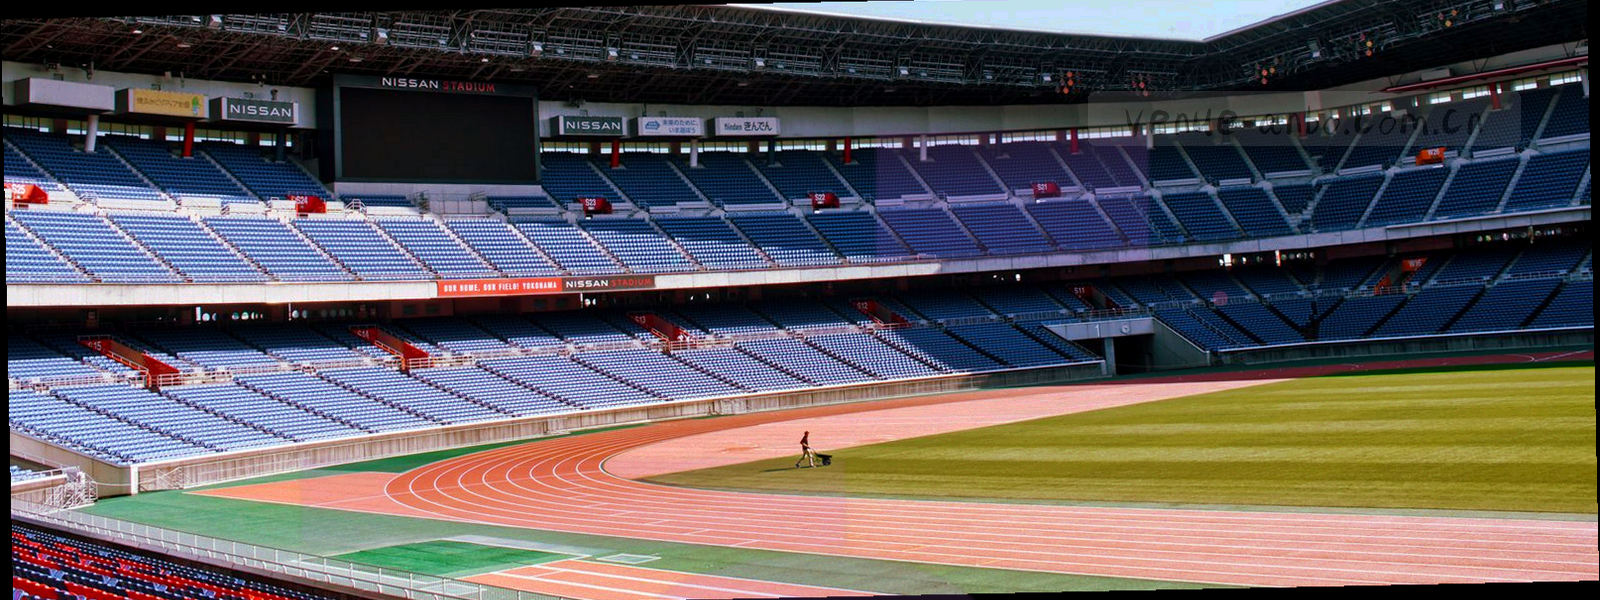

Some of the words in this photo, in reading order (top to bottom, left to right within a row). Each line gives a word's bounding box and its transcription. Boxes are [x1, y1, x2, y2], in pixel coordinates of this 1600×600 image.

[382, 77, 439, 89] NISSAN
[442, 80, 496, 93] STADIUM
[230, 104, 292, 117] NISSAN
[566, 120, 621, 131] NISSAN
[743, 121, 773, 131] きんでん
[12, 184, 26, 195] S25
[295, 195, 308, 205] S24
[585, 198, 597, 207] S23
[814, 193, 826, 201] S22
[443, 284, 457, 293] OUR
[522, 281, 557, 290] YOKOHAMA
[566, 279, 609, 289] NISSAN
[610, 277, 652, 287] STADIUM
